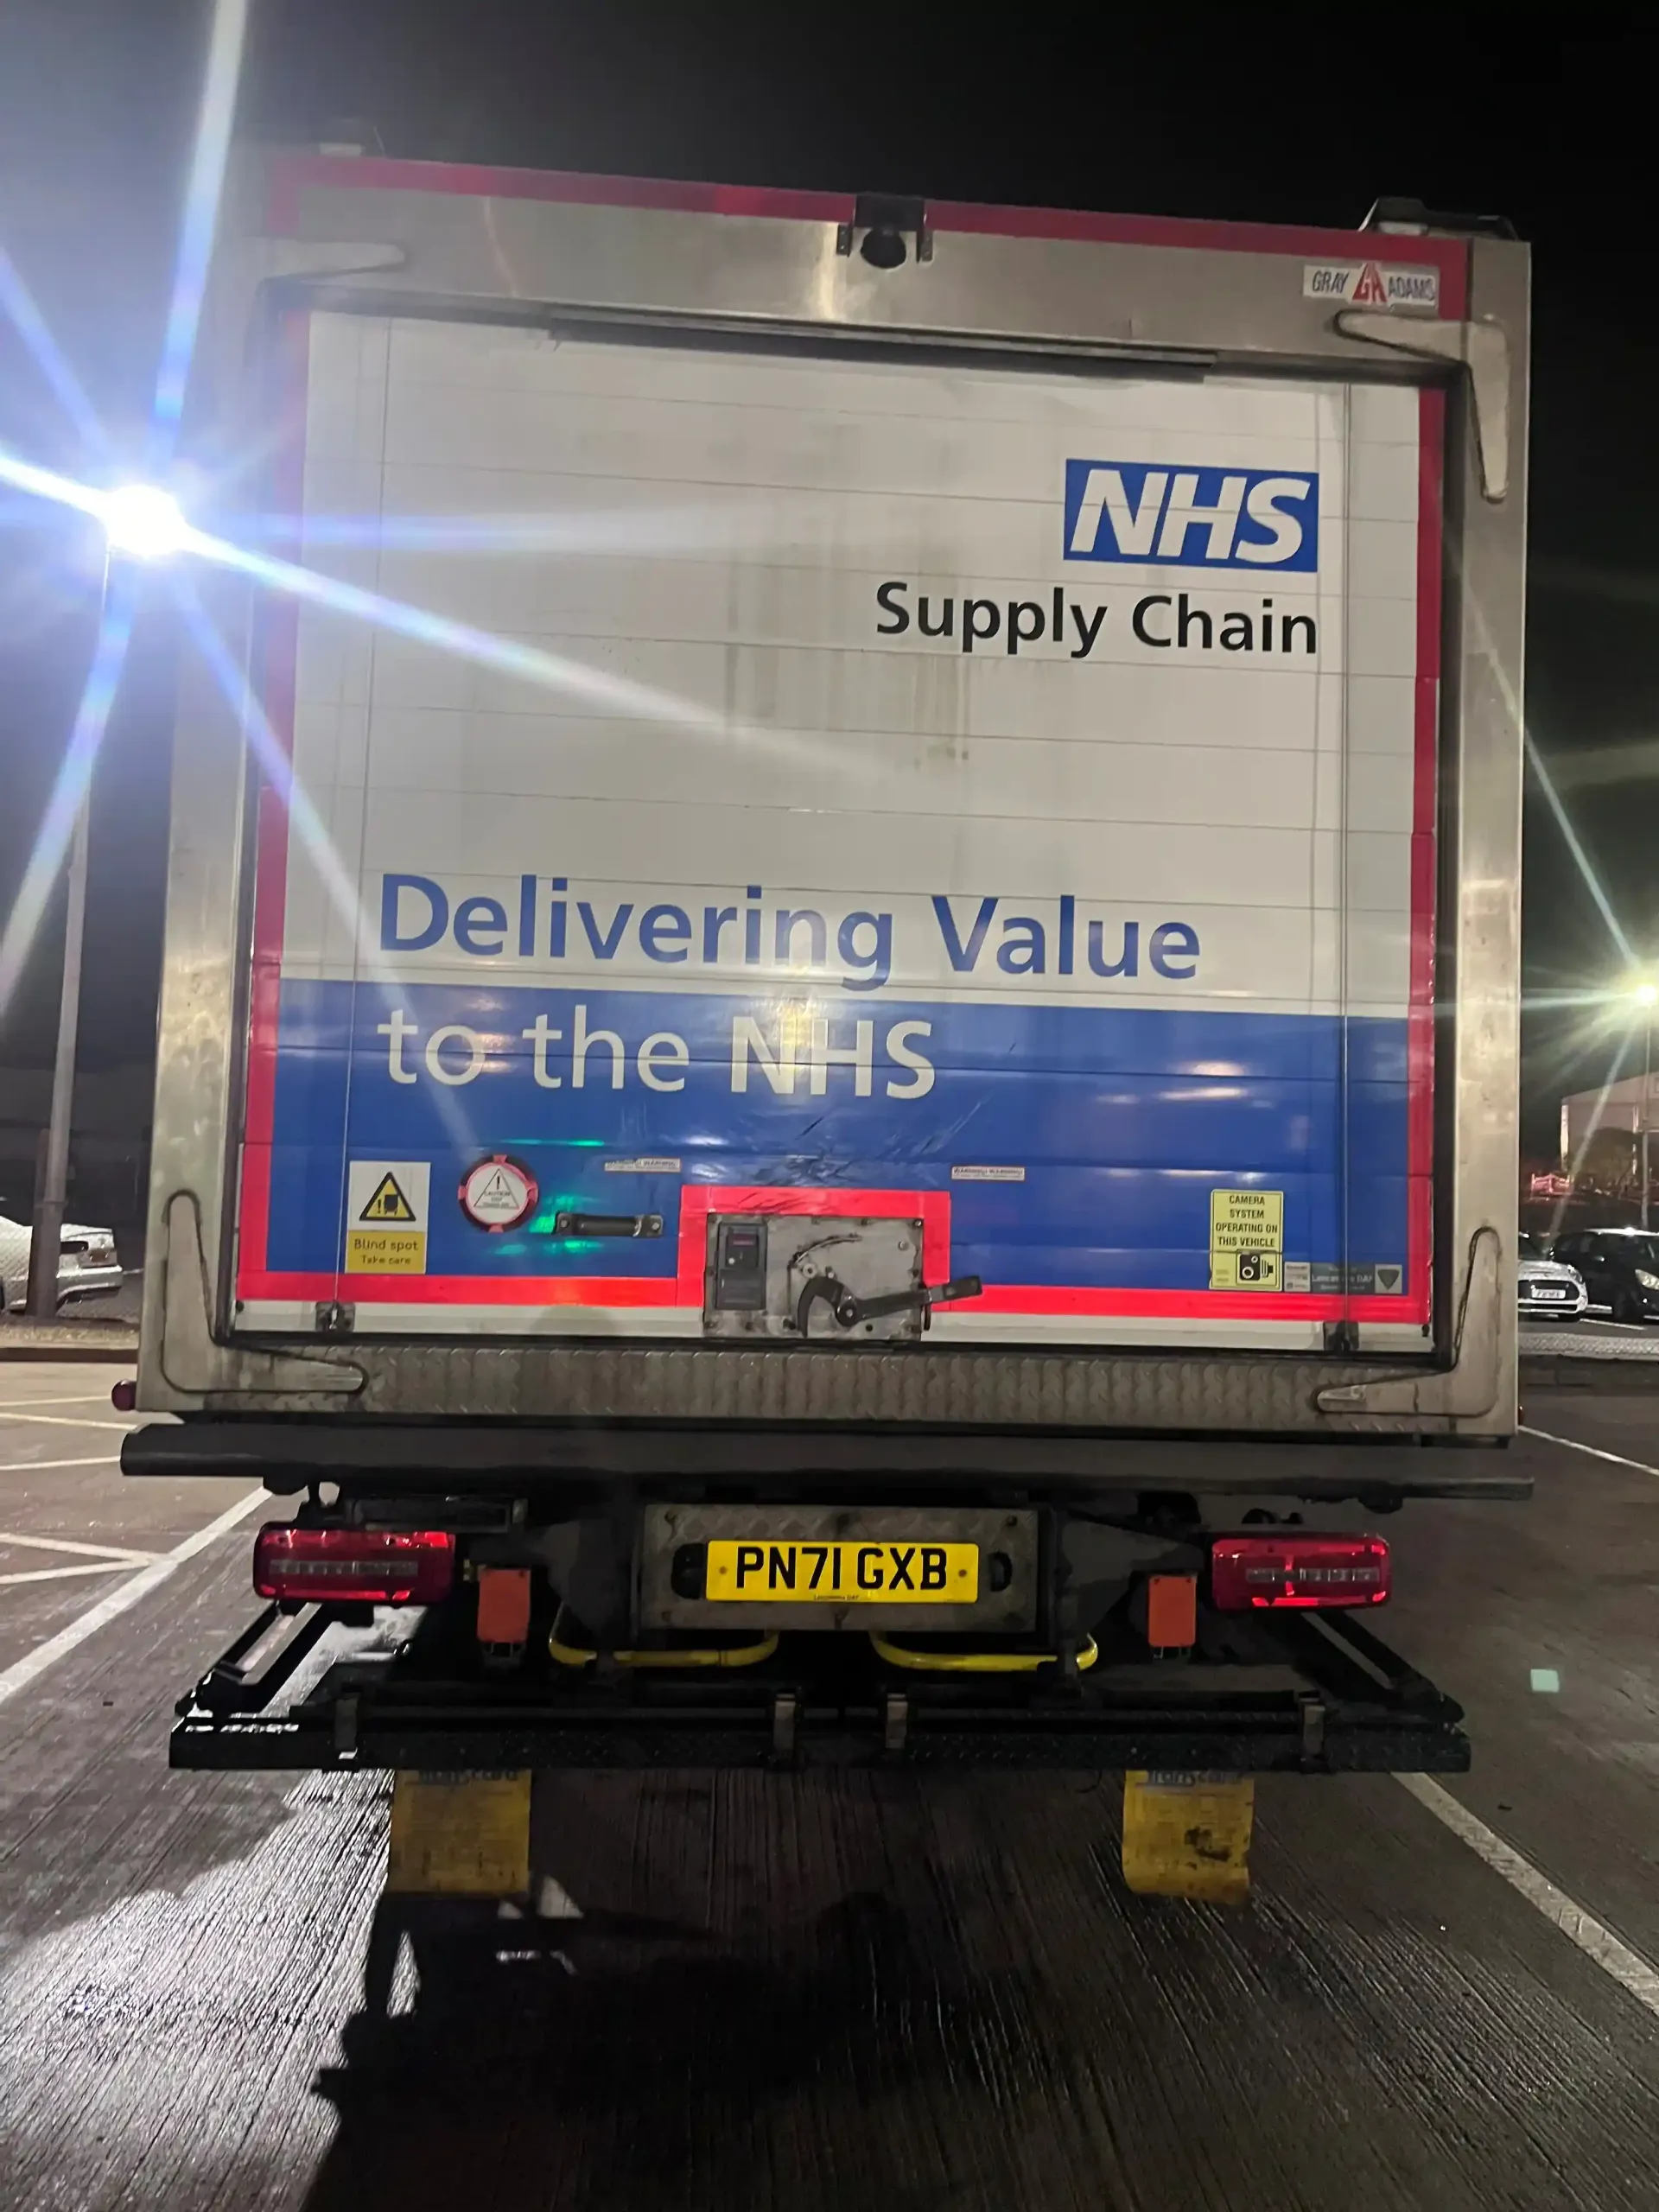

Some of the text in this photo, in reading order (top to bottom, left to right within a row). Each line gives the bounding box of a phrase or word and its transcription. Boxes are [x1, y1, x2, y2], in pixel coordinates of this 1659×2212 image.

[1312, 270, 1350, 294] GRAY
[1388, 276, 1435, 302] ADAMS
[1070, 468, 1312, 563] NHS
[875, 581, 1317, 658] Supply Chain
[379, 873, 1201, 991] Delivering Value
[376, 1005, 936, 1100] to the NHS
[1229, 1195, 1265, 1205] CAMERA
[1230, 1209, 1264, 1219] SYSTEM
[1215, 1222, 1278, 1234] OPERATING ON
[354, 1238, 418, 1253] Blind spot
[1218, 1236, 1275, 1248] THIS VEHICLE
[361, 1255, 411, 1265] Take care
[736, 1546, 947, 1591] PN71 GXB
